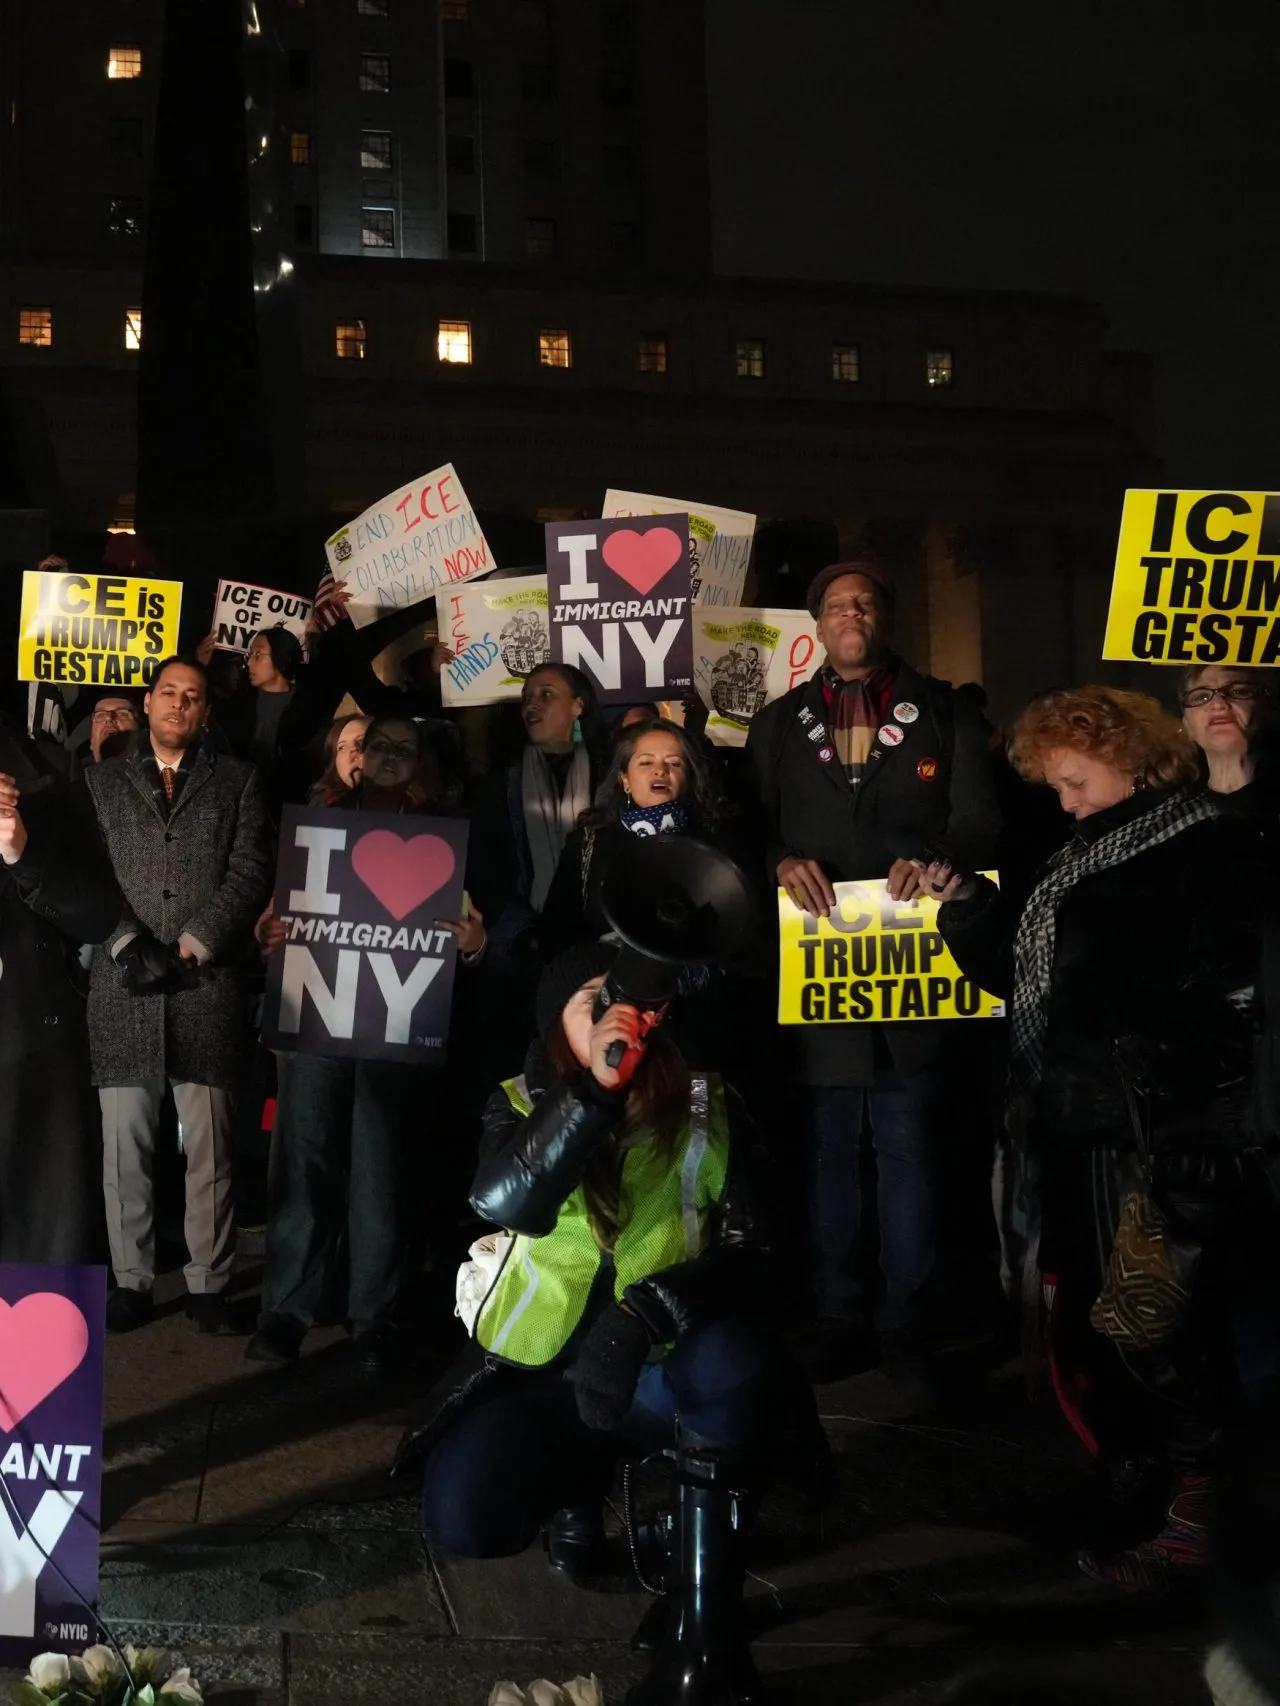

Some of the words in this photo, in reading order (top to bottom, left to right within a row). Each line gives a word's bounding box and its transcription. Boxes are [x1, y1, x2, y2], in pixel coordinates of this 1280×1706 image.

[356, 513, 395, 550] END
[396, 476, 460, 533] ICE
[1150, 493, 1280, 555] IC
[444, 537, 487, 582] NOW
[558, 534, 599, 600] I
[39, 575, 127, 617] ICE
[137, 587, 165, 619] is
[221, 585, 263, 608] ICE
[268, 595, 311, 620] OUT
[532, 590, 548, 599] ROA
[1140, 557, 1280, 611] TRUM
[235, 609, 262, 626] OF
[553, 598, 687, 622] IMMIGRANT
[710, 627, 734, 635] MAKE
[737, 625, 753, 633] THE
[754, 625, 778, 640] ROAD
[34, 615, 164, 654] TRUMP'S
[217, 623, 258, 649] NY
[561, 619, 684, 690] NY
[1132, 611, 1280, 664] GESTA
[34, 649, 160, 686] GESTAPO
[448, 632, 498, 691] HANDS
[289, 825, 347, 915] I
[280, 916, 452, 954] IMMIGRANT
[799, 932, 944, 978] TRUMP
[278, 944, 445, 1045] NY
[801, 975, 981, 1021] GESTAPO
[60, 1622, 89, 1641] NYIC
